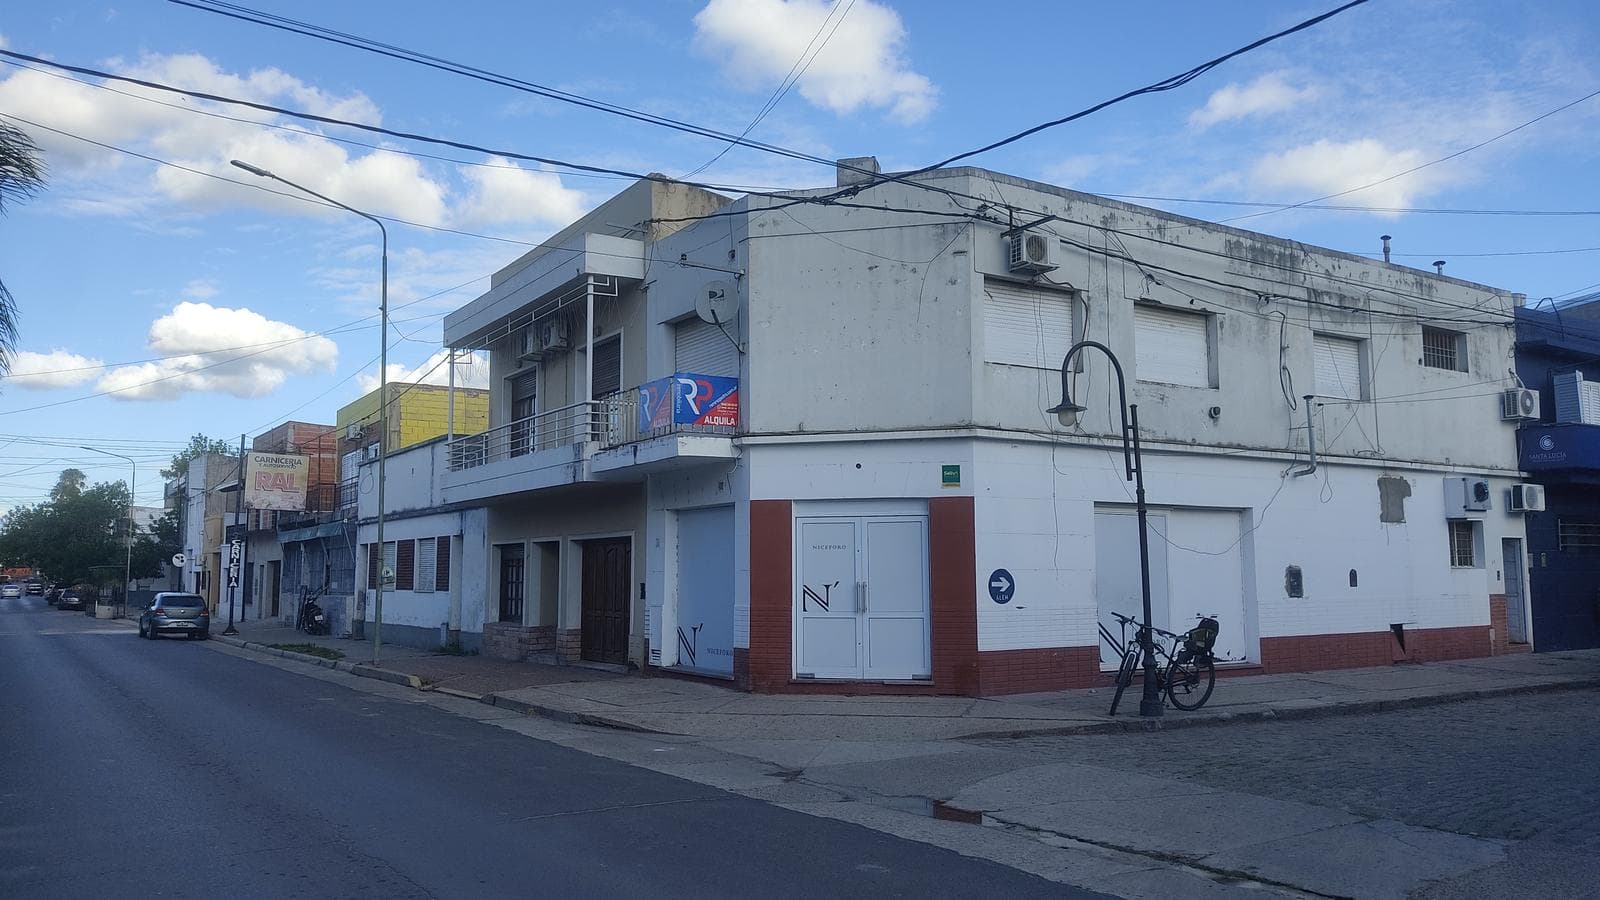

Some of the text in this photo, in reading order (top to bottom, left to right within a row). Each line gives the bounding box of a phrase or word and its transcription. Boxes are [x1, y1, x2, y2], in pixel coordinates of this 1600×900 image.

[677, 379, 713, 415] RP
[704, 415, 736, 426] ALQUILA
[254, 455, 303, 465] CARNICERIA
[255, 471, 299, 493] RAL
